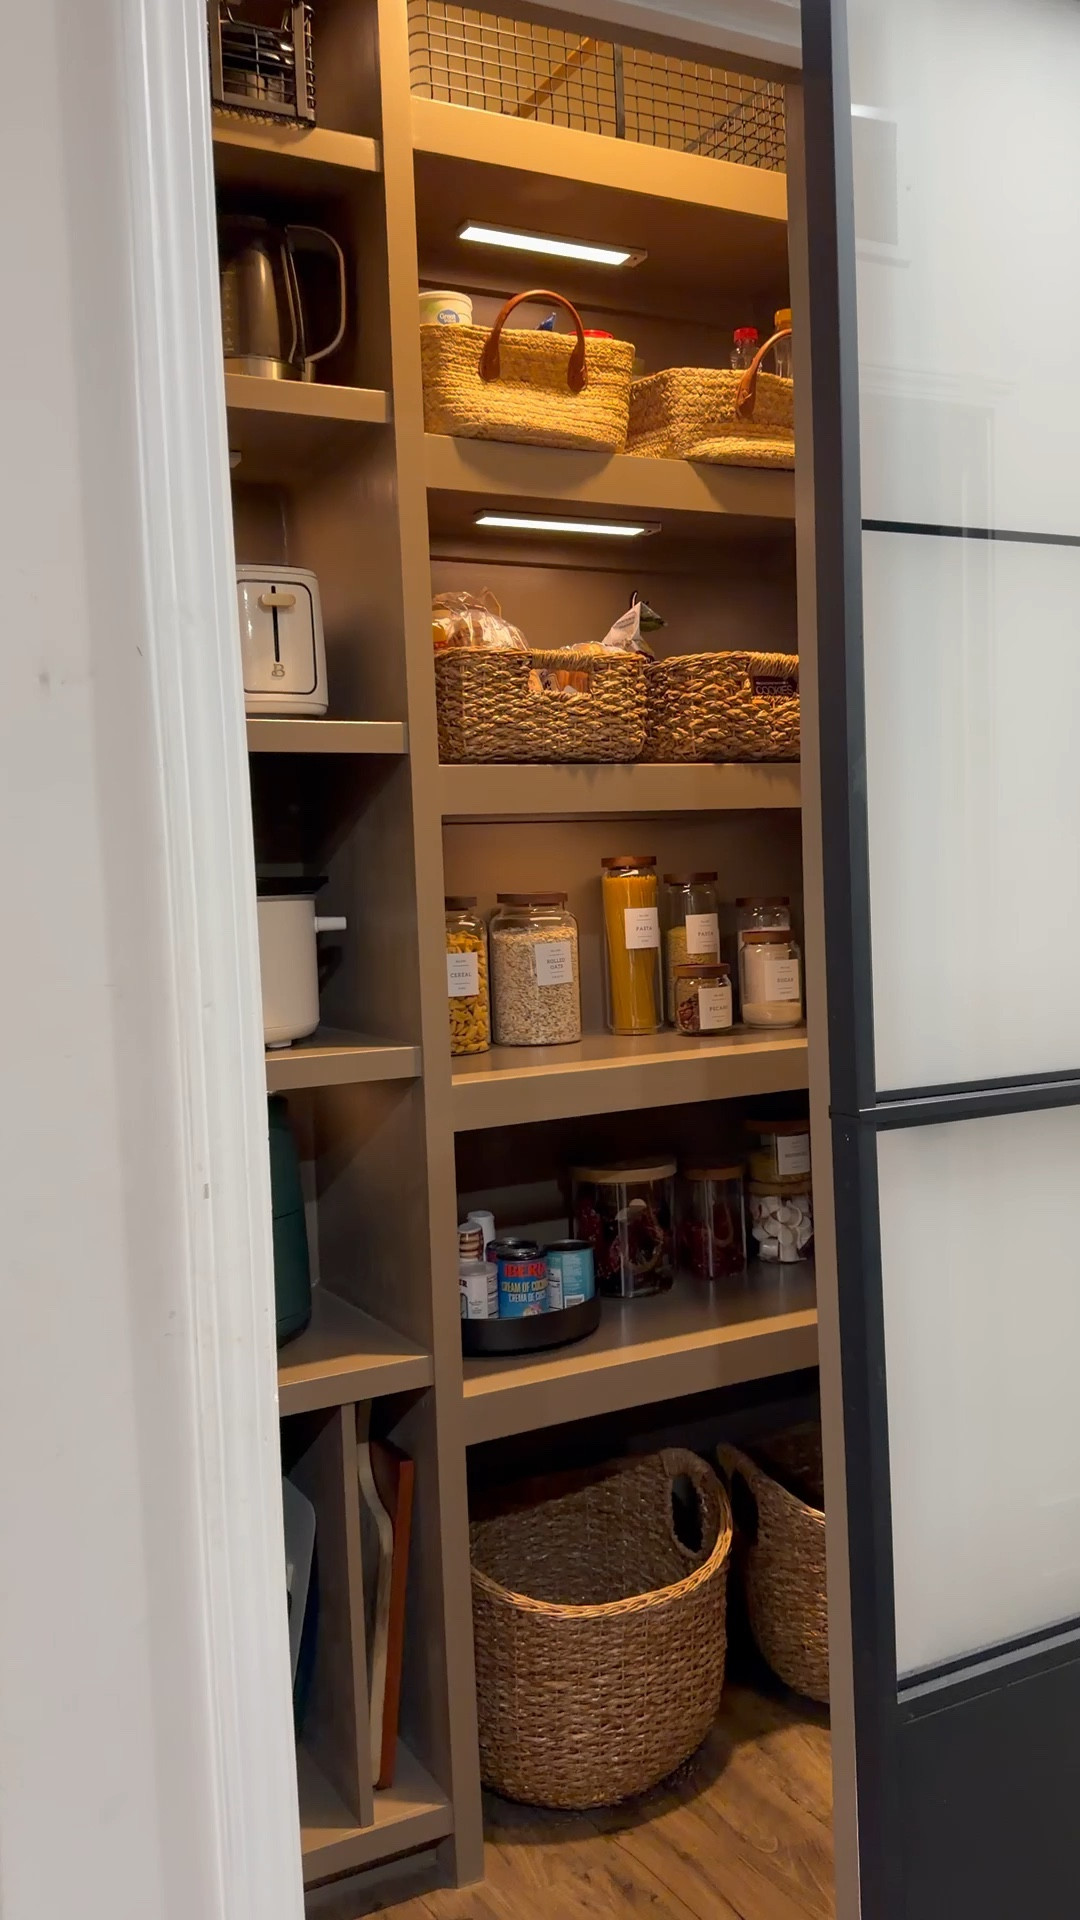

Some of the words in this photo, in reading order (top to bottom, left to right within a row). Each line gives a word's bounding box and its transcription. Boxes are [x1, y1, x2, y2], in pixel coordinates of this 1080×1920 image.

[756, 686, 792, 695] COOKIES
[501, 1281, 520, 1293] CREAM
[521, 1281, 530, 1293] OF
[508, 1293, 528, 1303] CREMA
[528, 1293, 535, 1302] DE
